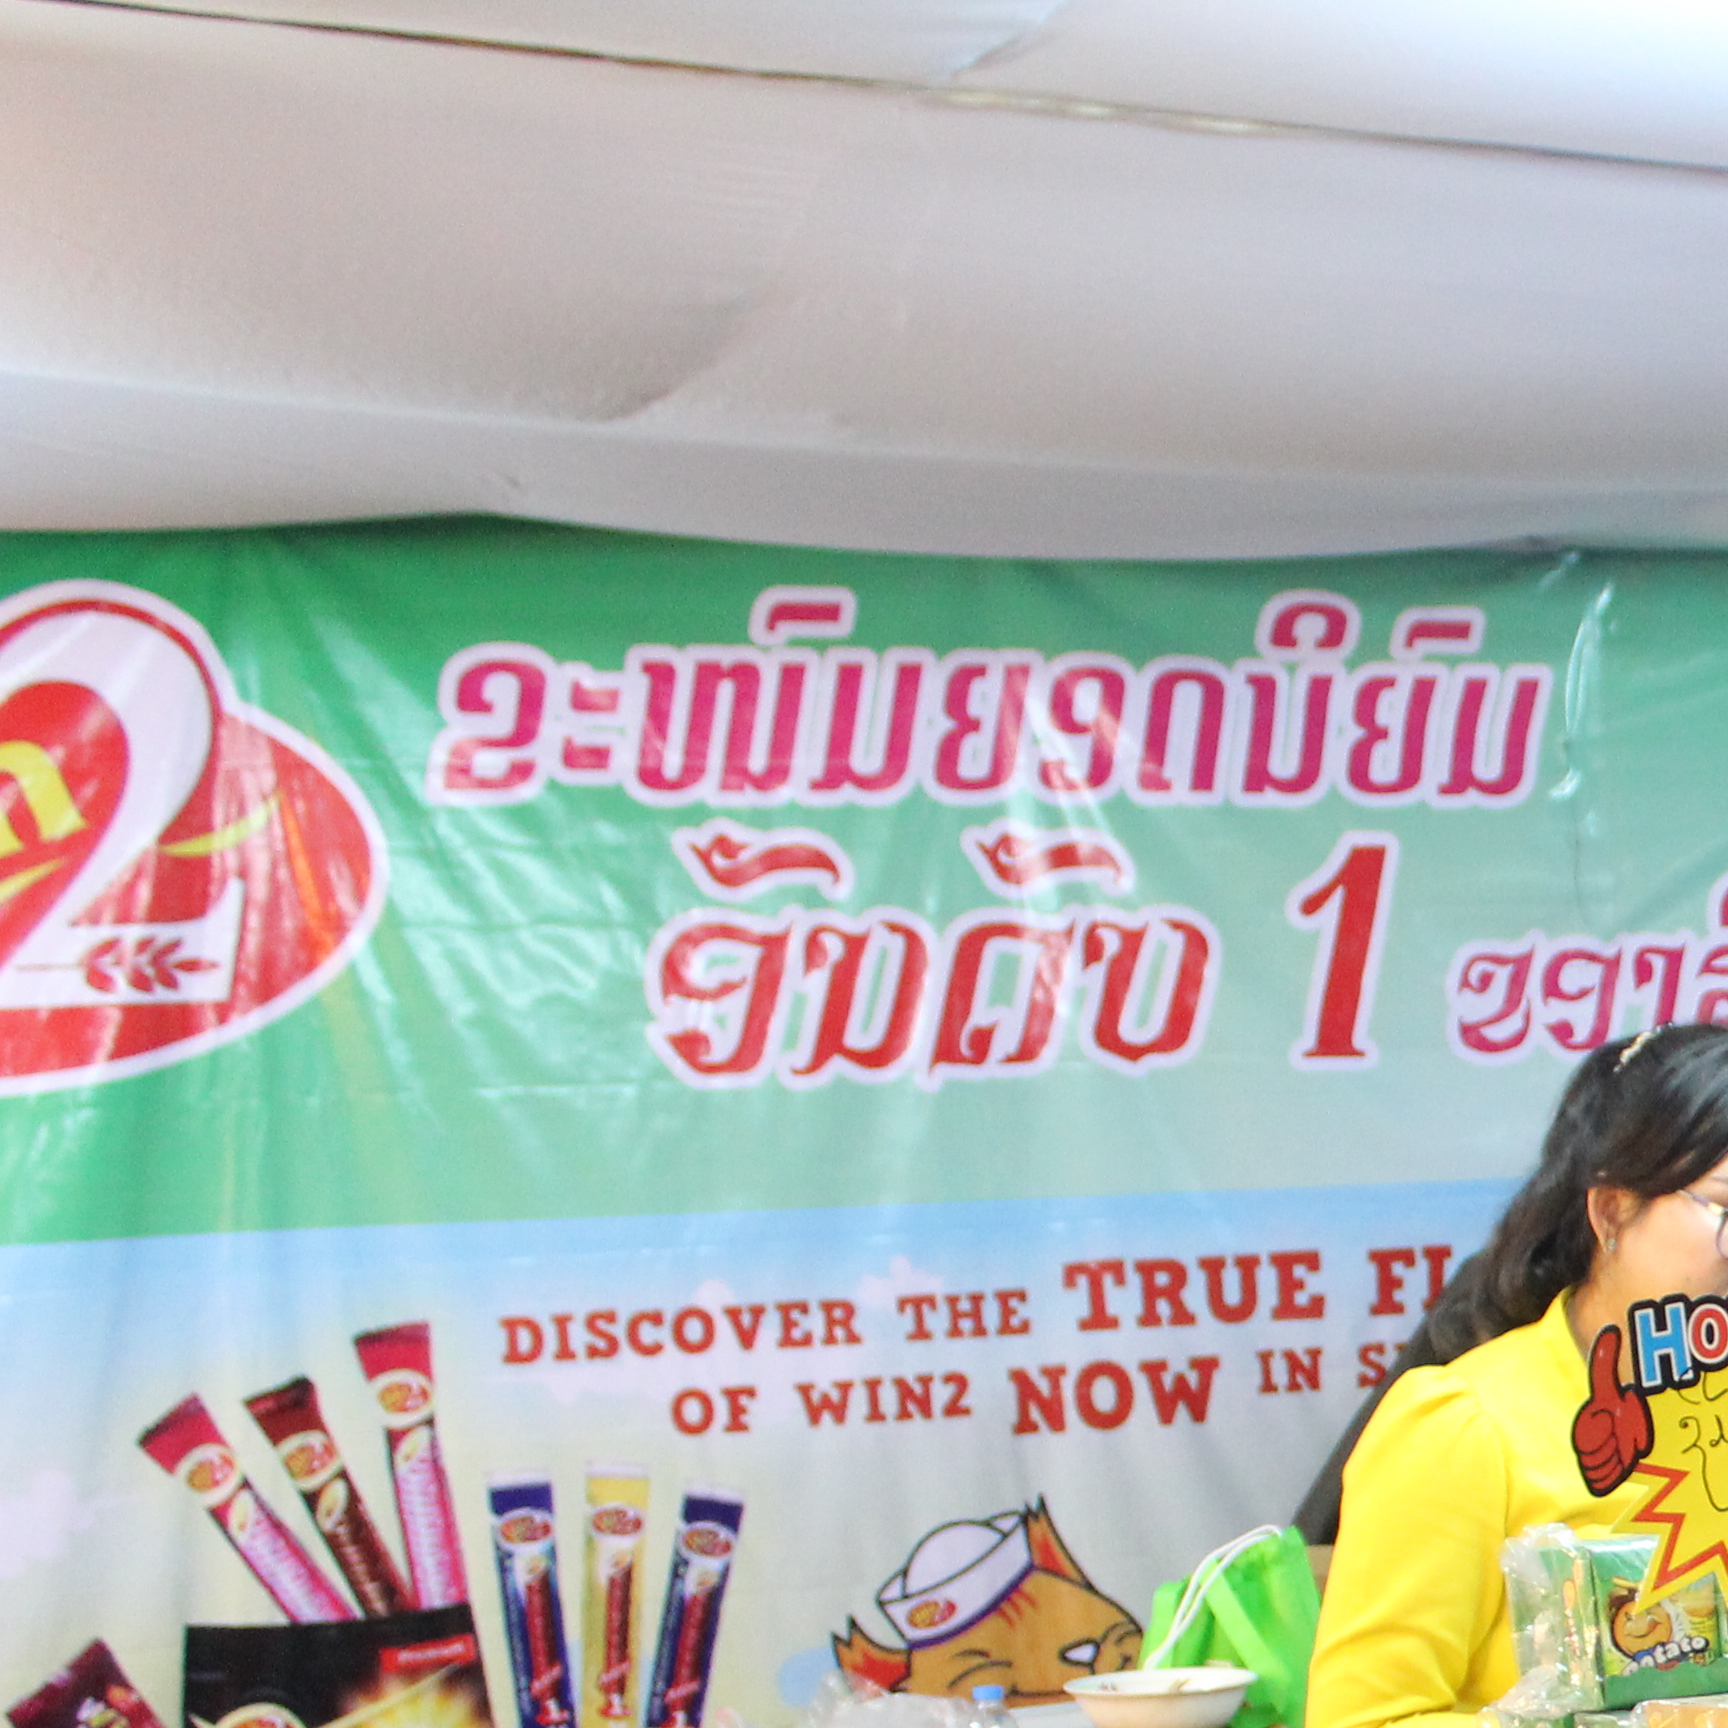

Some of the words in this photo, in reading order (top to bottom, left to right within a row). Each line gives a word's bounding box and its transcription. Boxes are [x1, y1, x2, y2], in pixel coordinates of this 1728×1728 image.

[660, 828, 1210, 1079] ອັນດັບ
[1298, 844, 1387, 1058] 1
[501, 1298, 863, 1364] DISCOVER
[897, 1289, 1031, 1342] THE
[1063, 1249, 1325, 1332] TRUE
[671, 1384, 758, 1436] OF
[797, 1371, 972, 1428] WIN2
[1008, 1355, 1220, 1435] NOW
[1257, 1346, 1324, 1394] IN
